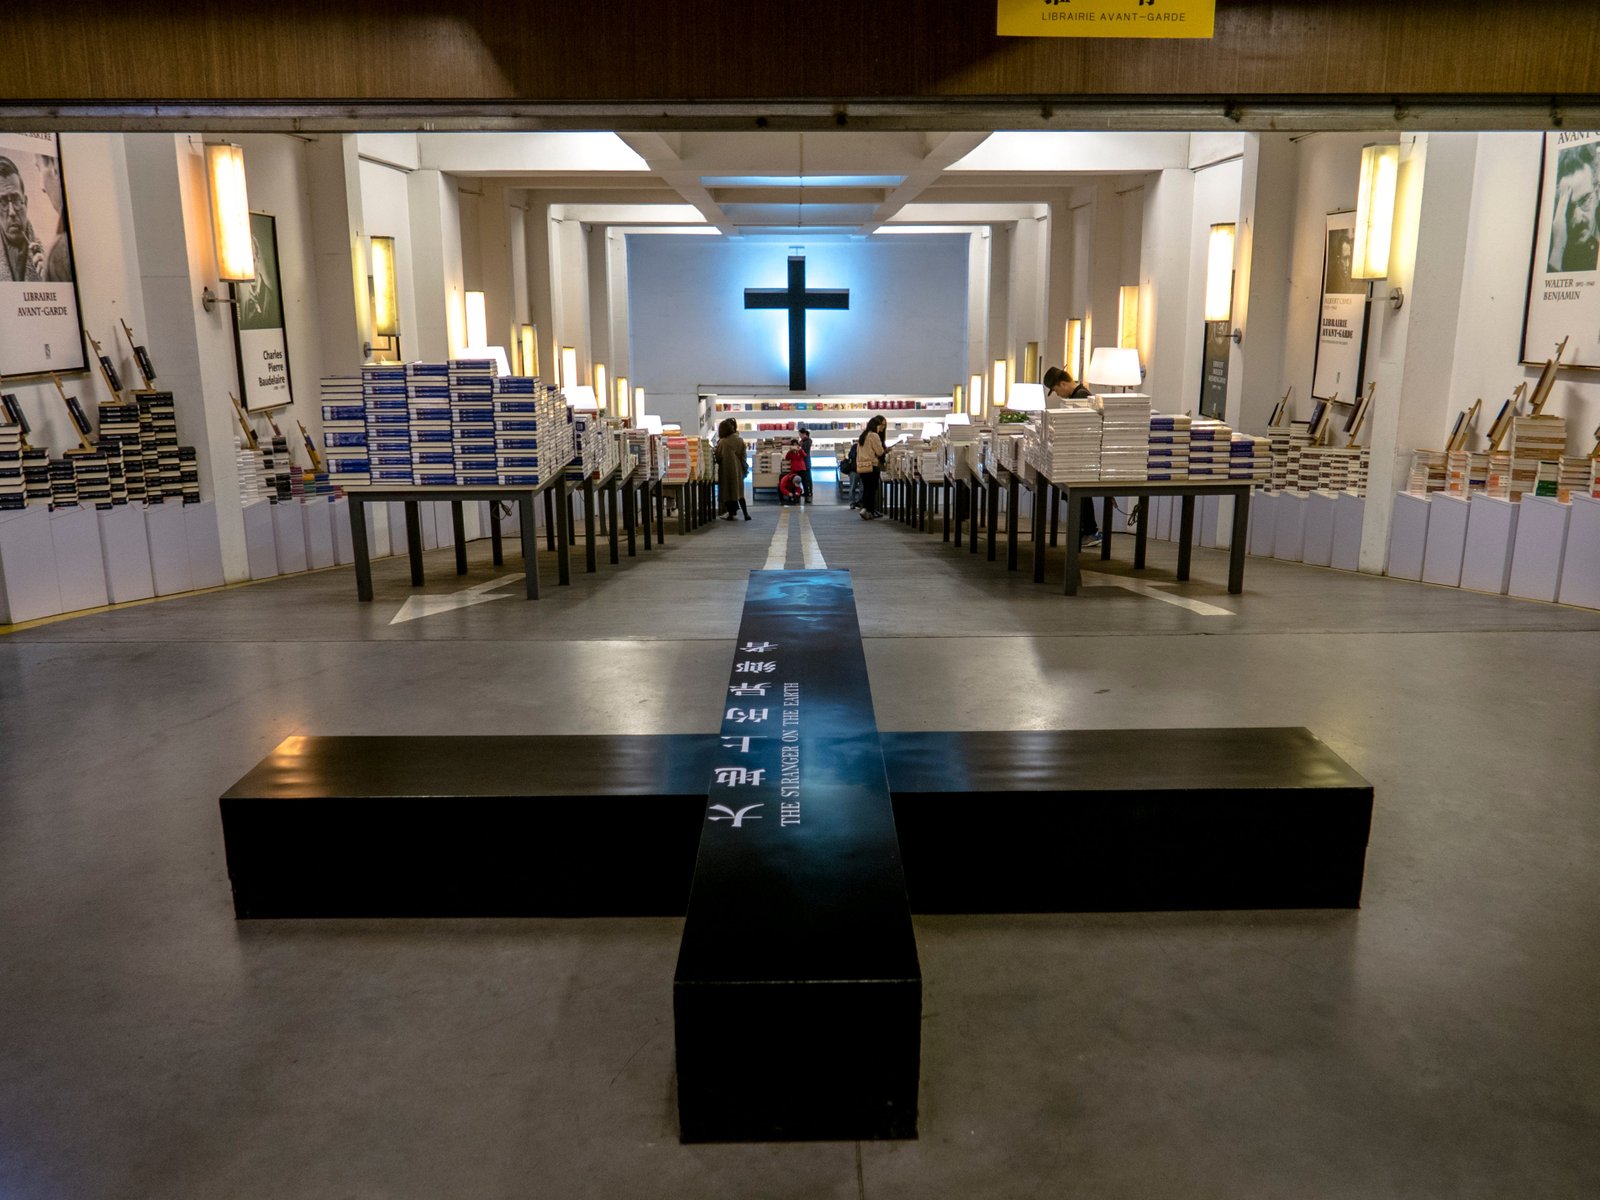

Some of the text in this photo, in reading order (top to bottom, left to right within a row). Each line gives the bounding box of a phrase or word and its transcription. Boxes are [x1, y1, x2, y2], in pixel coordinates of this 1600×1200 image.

[1042, 12, 1185, 22] LIBRAIRIE AVANT-GARDE
[1545, 279, 1574, 288] WALTER
[23, 292, 57, 301] LIBRAIRIE
[1543, 291, 1581, 302] BENJAMIN
[17, 306, 68, 317] AVANT-GARDE
[1322, 318, 1347, 328] LIBRAIRIE
[1322, 328, 1353, 339] AVANT-GARDE
[263, 349, 282, 360] Charles
[268, 362, 284, 372] Pierre
[258, 374, 285, 387] Baudelaire
[781, 682, 801, 827] THE STRANGER ON THE EARTH
